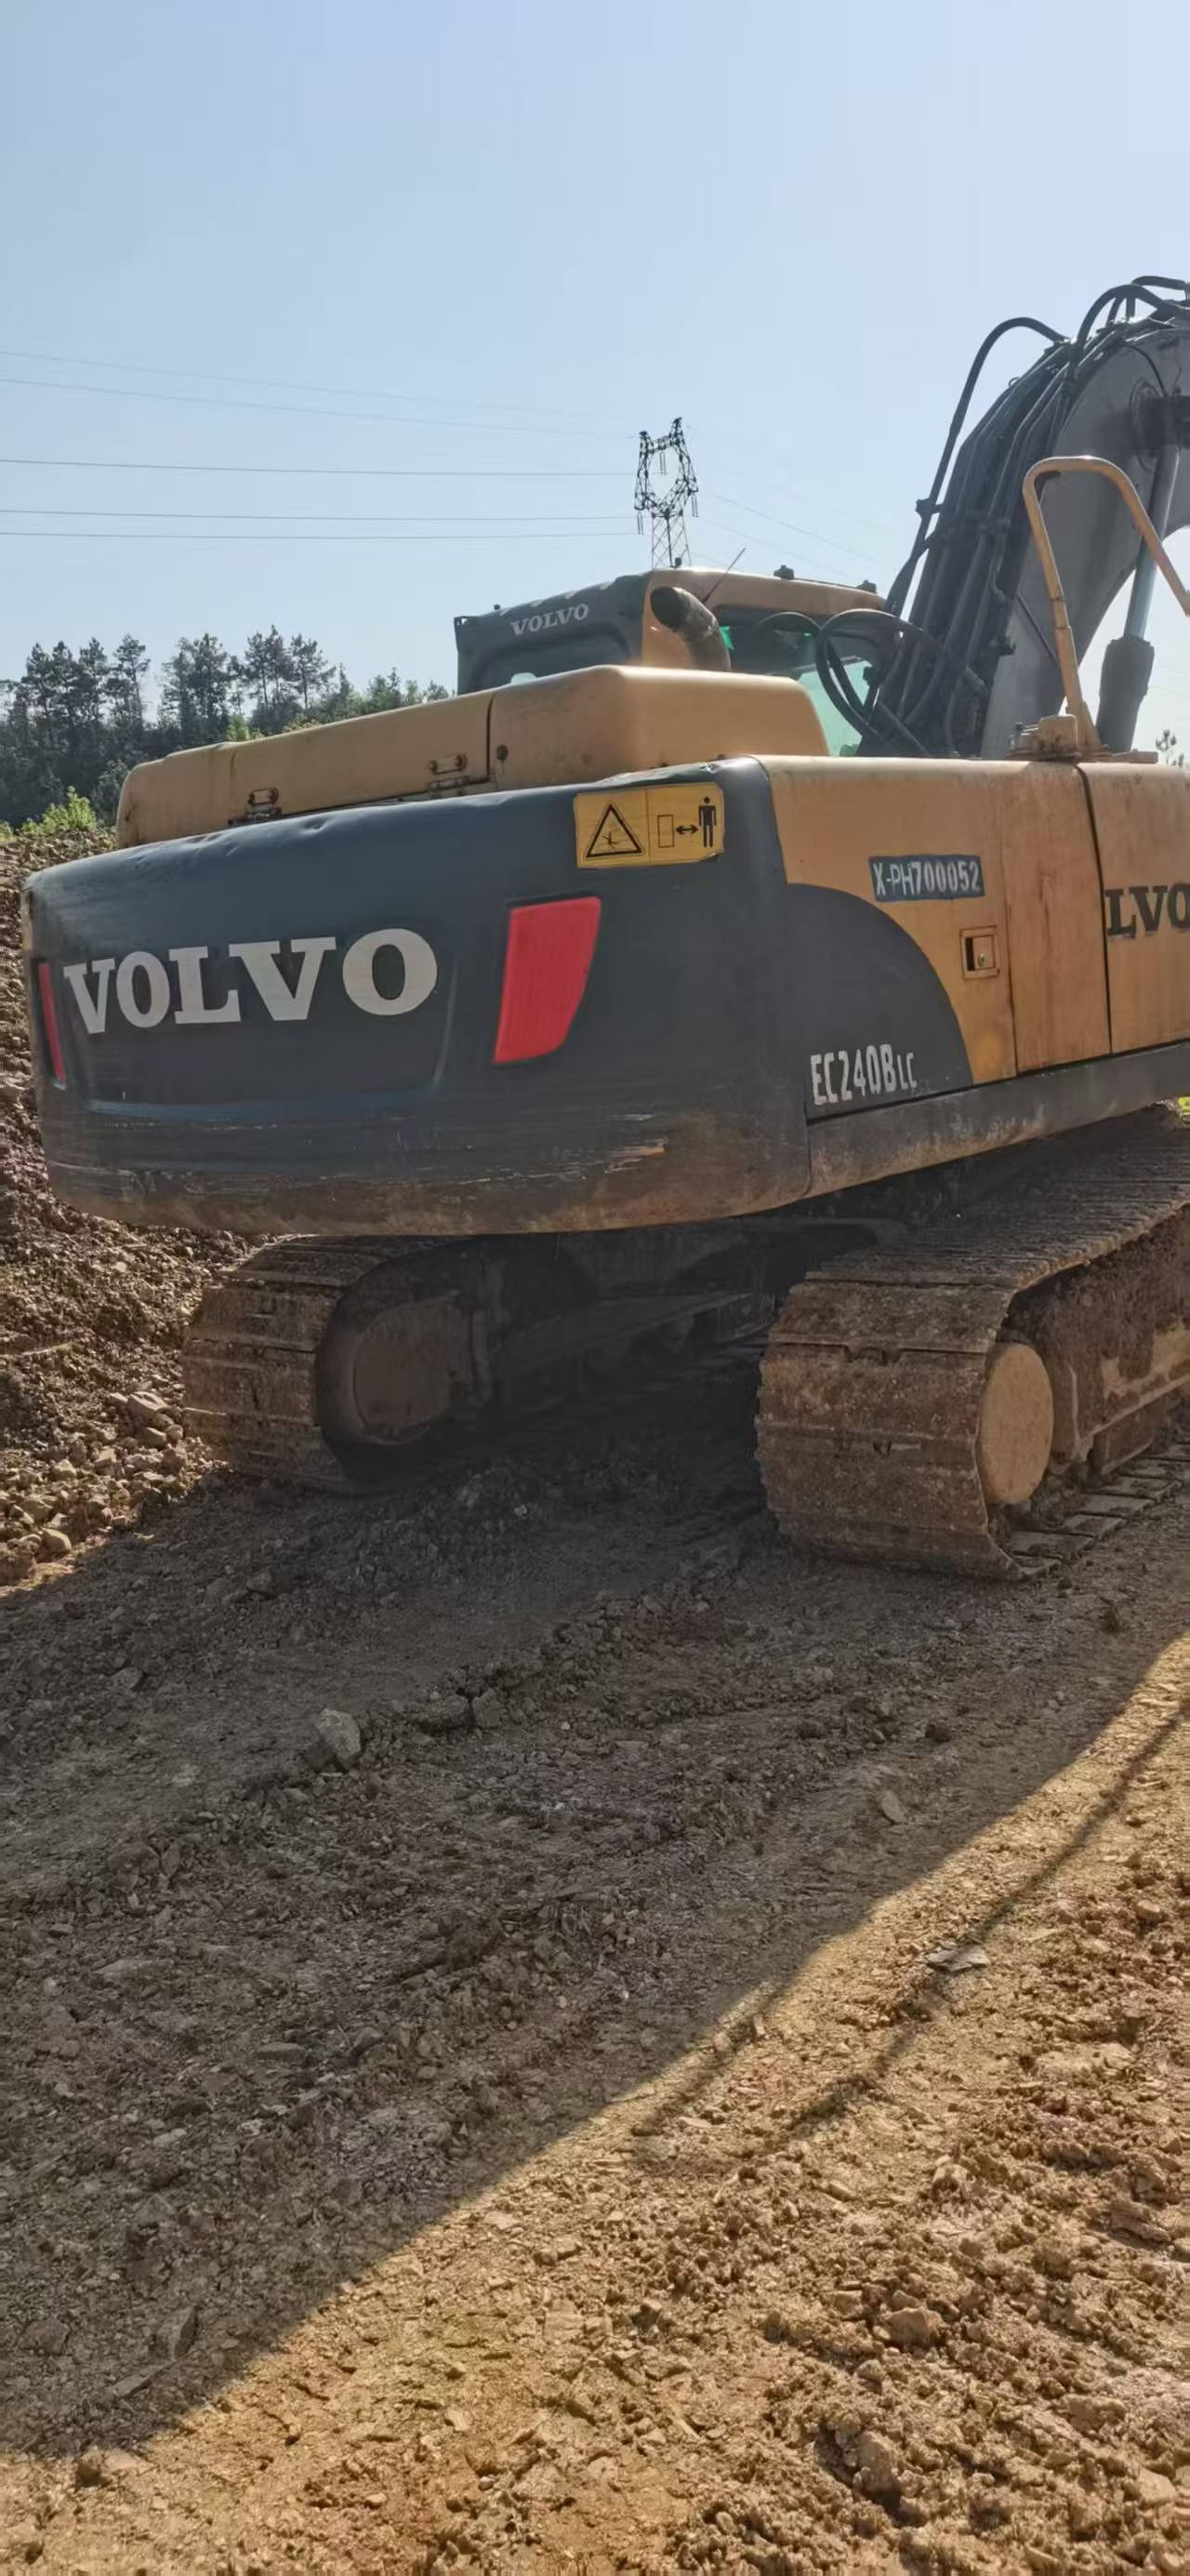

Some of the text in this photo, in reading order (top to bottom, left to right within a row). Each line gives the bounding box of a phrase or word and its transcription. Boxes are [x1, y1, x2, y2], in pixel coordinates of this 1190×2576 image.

[510, 604, 589, 635] VOLVO
[873, 860, 981, 896] X-PH700052
[1104, 883, 1190, 939] LVO
[63, 928, 438, 1034] VOLVO
